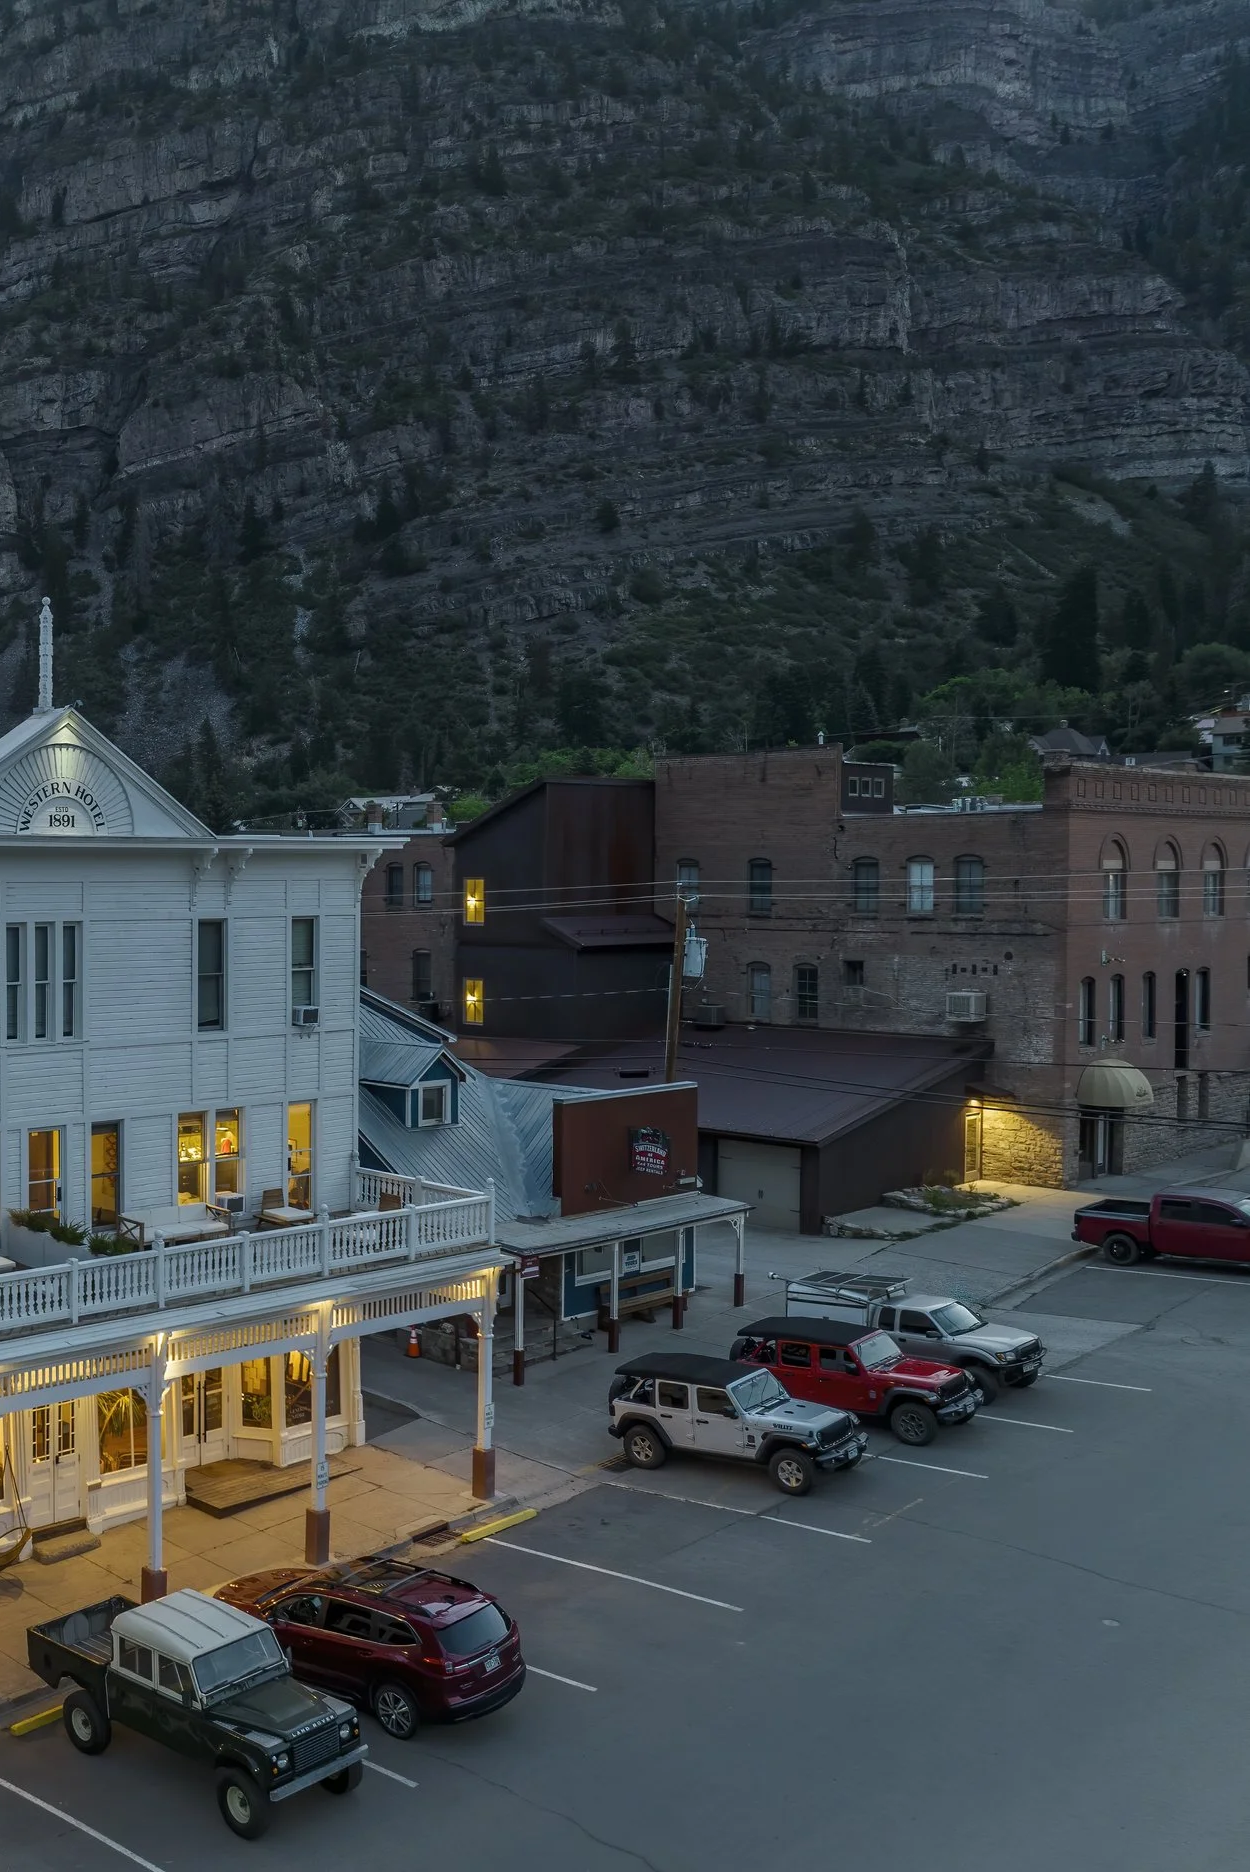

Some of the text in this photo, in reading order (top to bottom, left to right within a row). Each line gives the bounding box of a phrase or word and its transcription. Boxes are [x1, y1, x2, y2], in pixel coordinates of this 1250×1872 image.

[19, 781, 105, 831] WESTERN HOTEL
[49, 814, 75, 828] 1891
[634, 1144, 667, 1157] SWITZERLAND
[635, 1154, 665, 1165] AMERICA
[647, 1162, 663, 1170] TOURS
[646, 1168, 663, 1176] RENTALS
[291, 1714, 335, 1738] LAND ROVER
